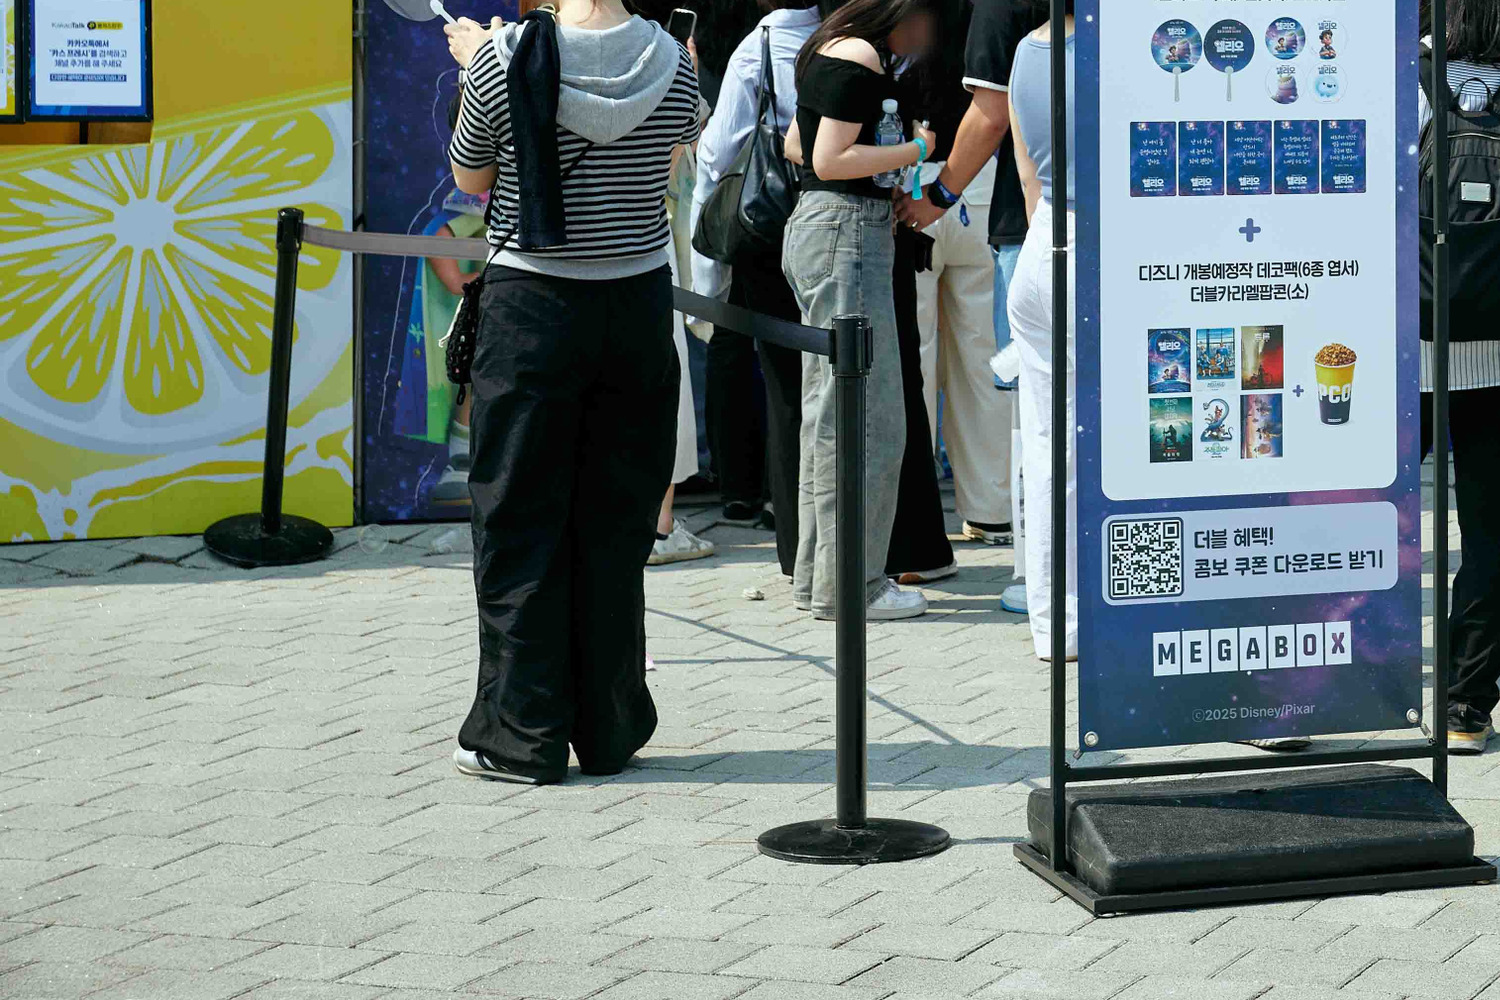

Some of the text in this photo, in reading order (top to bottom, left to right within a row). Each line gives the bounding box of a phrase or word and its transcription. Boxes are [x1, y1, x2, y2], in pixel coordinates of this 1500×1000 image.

[1139, 260, 1359, 281] 디즈니 개봉예정작 데코팩(6종 엽서)
[1191, 283, 1309, 303] 더블카라멜팝콘(소)
[1194, 527, 1274, 549] 더블 혜택!
[1194, 549, 1384, 579] 콤보 쿠폰 다운로드 받기
[1157, 631, 1346, 666] MEGABOX
[1192, 703, 1316, 723] ©2025 Disney/Pixar
